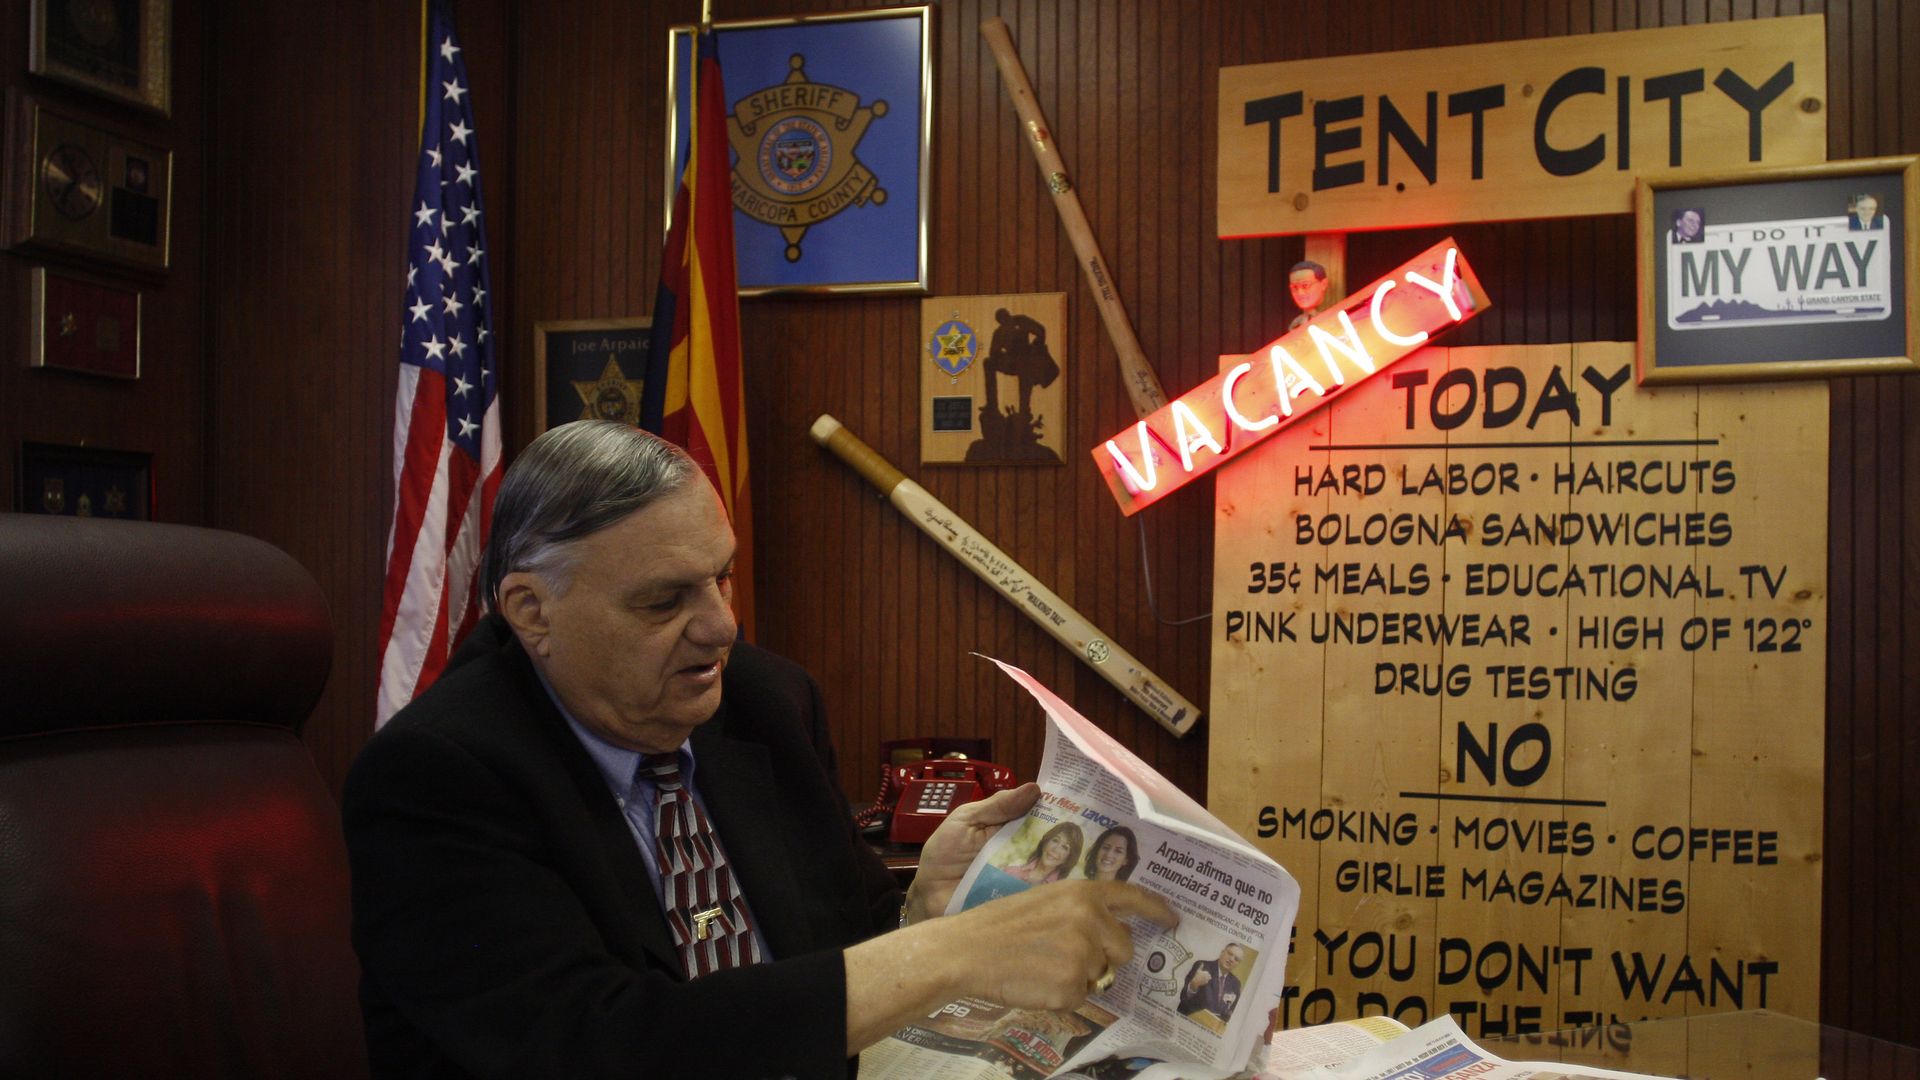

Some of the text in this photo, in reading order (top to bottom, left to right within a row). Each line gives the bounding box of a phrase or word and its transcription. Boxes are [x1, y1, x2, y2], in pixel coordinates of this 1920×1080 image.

[750, 87, 844, 117] SHERIFF
[1244, 61, 1795, 194] TENT CITY
[808, 171, 864, 218] COUNTY
[1729, 226, 1825, 243] I DO IT
[1681, 240, 1878, 298] MY WAY
[1806, 293, 1882, 306] GRAND CANYON STATE
[572, 340, 597, 354] Joe
[1106, 248, 1462, 491] VACANCY
[1392, 364, 1631, 430] TODAY
[1294, 460, 1736, 496] HARD LABOR HAIRCUTS
[1296, 512, 1732, 546] BOLOGNA SANDWICHES
[1248, 562, 1787, 599] 35¢ MEALS EDUCATIONAL TV
[1226, 610, 1812, 653] PINK UNDERWEAR HIGH OF 122°
[1375, 663, 1637, 702] DRUG TESTING
[1456, 721, 1550, 787] NO
[1258, 806, 1778, 865] SMOKING MOVIES COFFEE
[1146, 860, 1269, 926] renunciará a su cargo
[1156, 841, 1194, 869] Arpaio
[1196, 860, 1232, 886] afirma
[1234, 879, 1255, 897] que
[1258, 890, 1272, 905] no
[1336, 860, 1685, 914] GIRLIE MAGAZINES
[1314, 928, 1416, 982] YOU
[1438, 938, 1592, 996] DON'T
[1611, 951, 1778, 1009] WANT
[1282, 986, 1336, 1030] TO
[1450, 1001, 1542, 1038] THE
